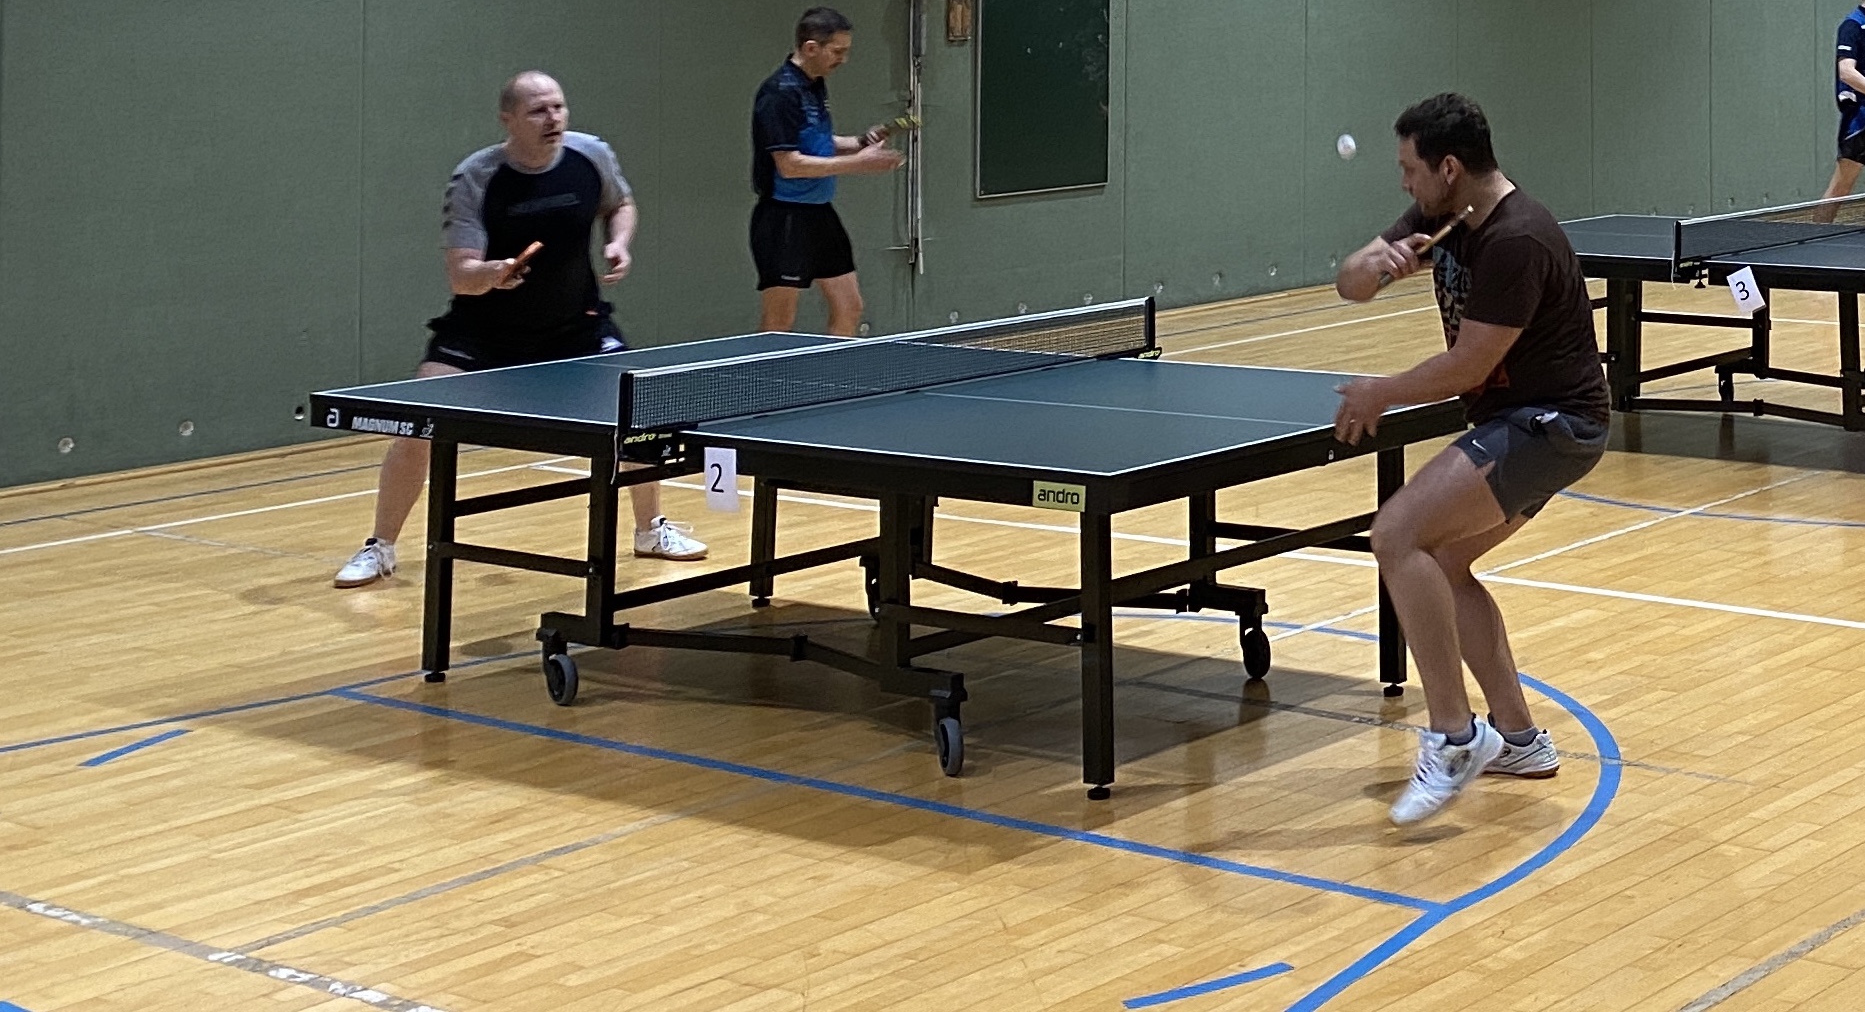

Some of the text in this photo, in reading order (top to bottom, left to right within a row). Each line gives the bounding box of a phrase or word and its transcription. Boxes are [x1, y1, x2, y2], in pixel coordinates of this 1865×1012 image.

[1735, 281, 1749, 300] 3
[351, 416, 399, 434] MAGNUM
[399, 422, 414, 436] SC
[623, 433, 657, 444] andro
[710, 463, 724, 493] 2
[1037, 488, 1080, 505] andro
